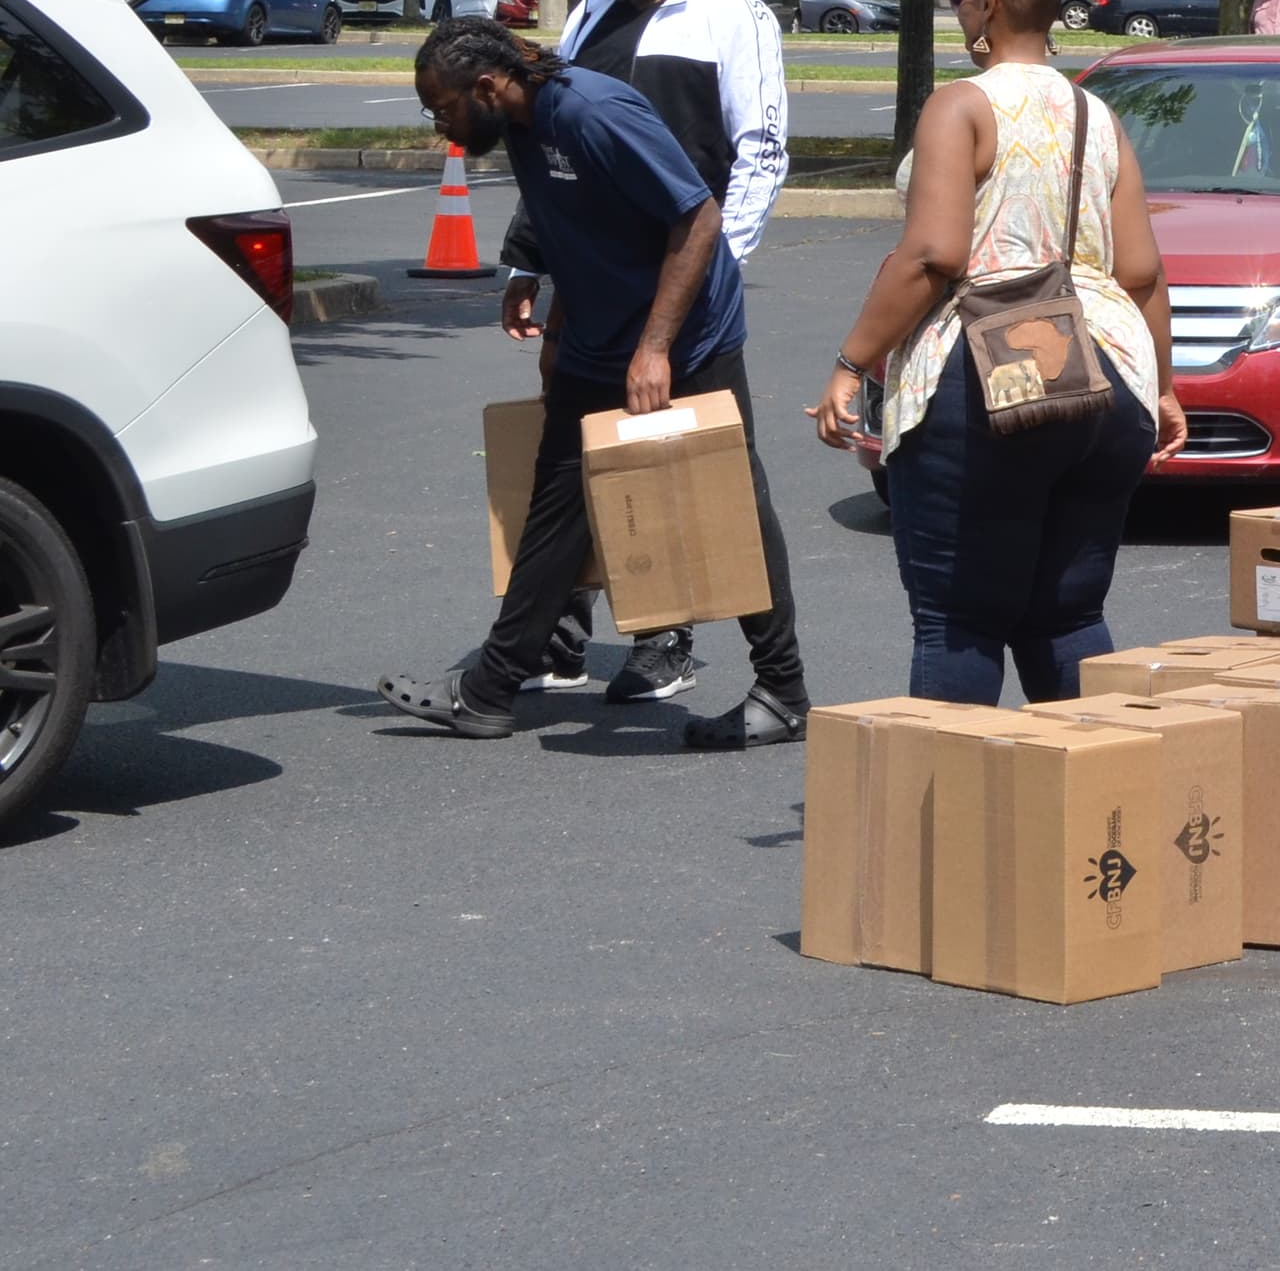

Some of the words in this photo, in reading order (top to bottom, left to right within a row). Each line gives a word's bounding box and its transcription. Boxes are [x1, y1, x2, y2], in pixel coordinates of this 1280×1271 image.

[761, 104, 782, 174] GUESS
[1188, 784, 1203, 857] CFBNJ
[1106, 857, 1122, 930] CFBNJ
